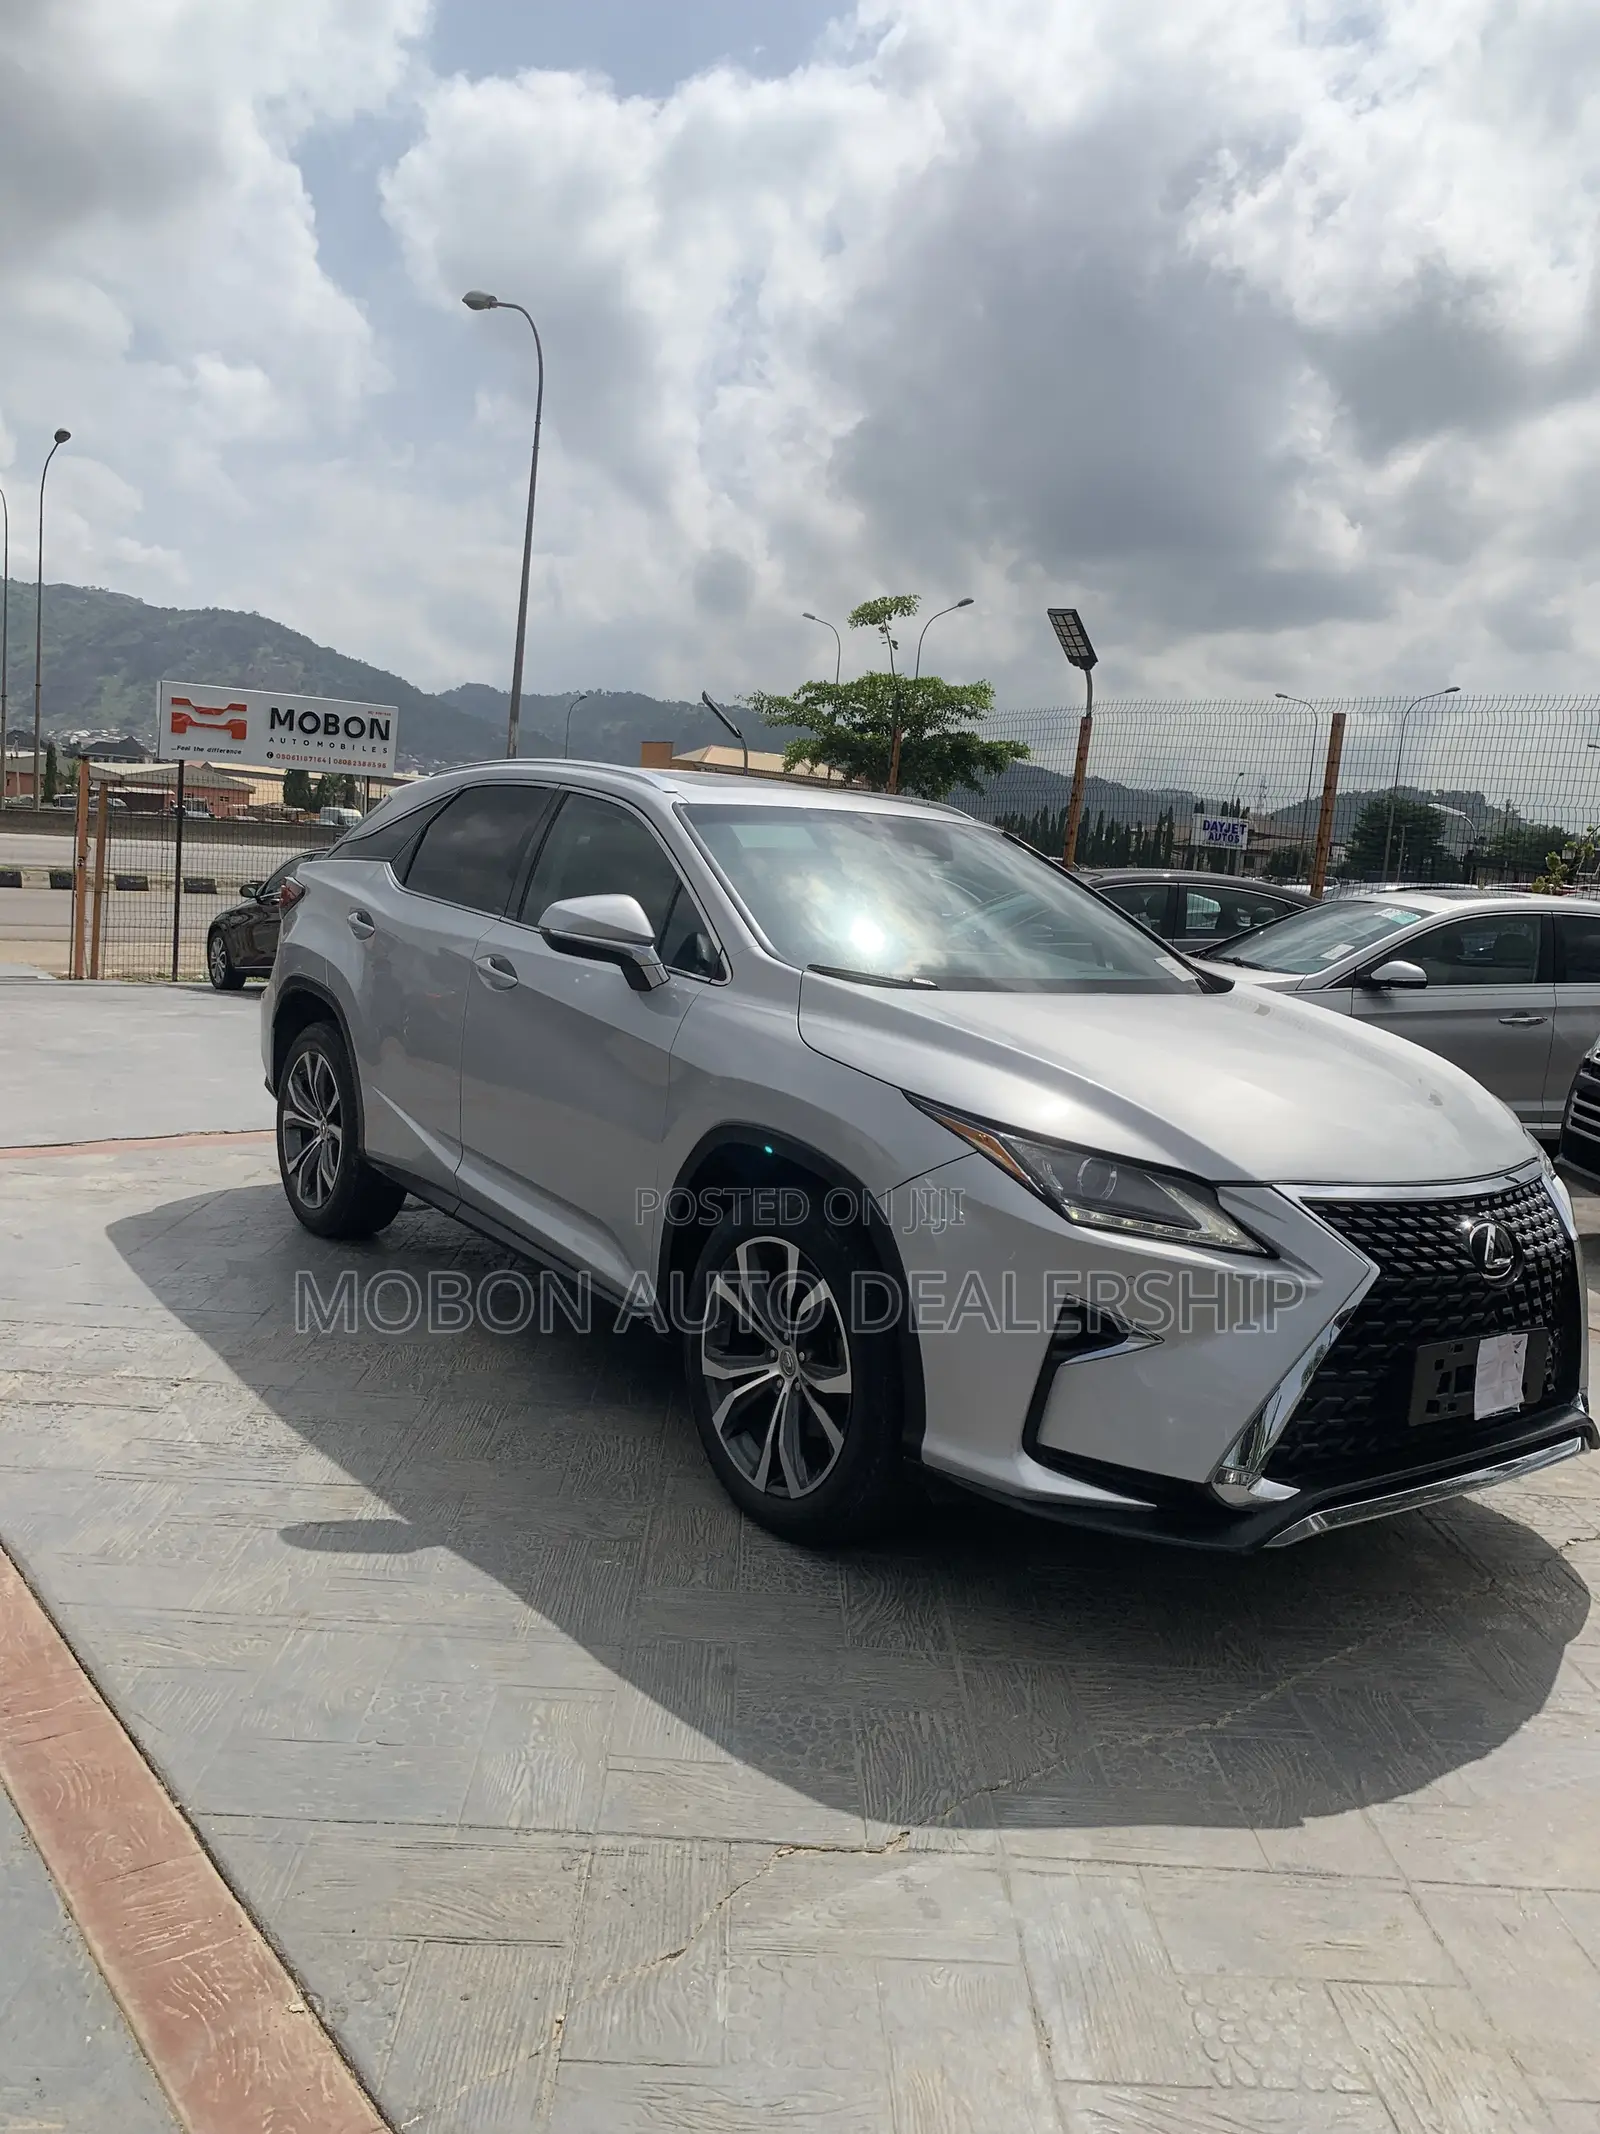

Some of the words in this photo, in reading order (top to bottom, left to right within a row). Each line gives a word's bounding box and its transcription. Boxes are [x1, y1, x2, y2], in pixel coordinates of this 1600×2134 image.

[269, 707, 391, 741] MOBON
[269, 737, 388, 753] AUTOMOBILES
[1203, 820, 1247, 835] DAYJET
[1208, 832, 1240, 843] AUTOS
